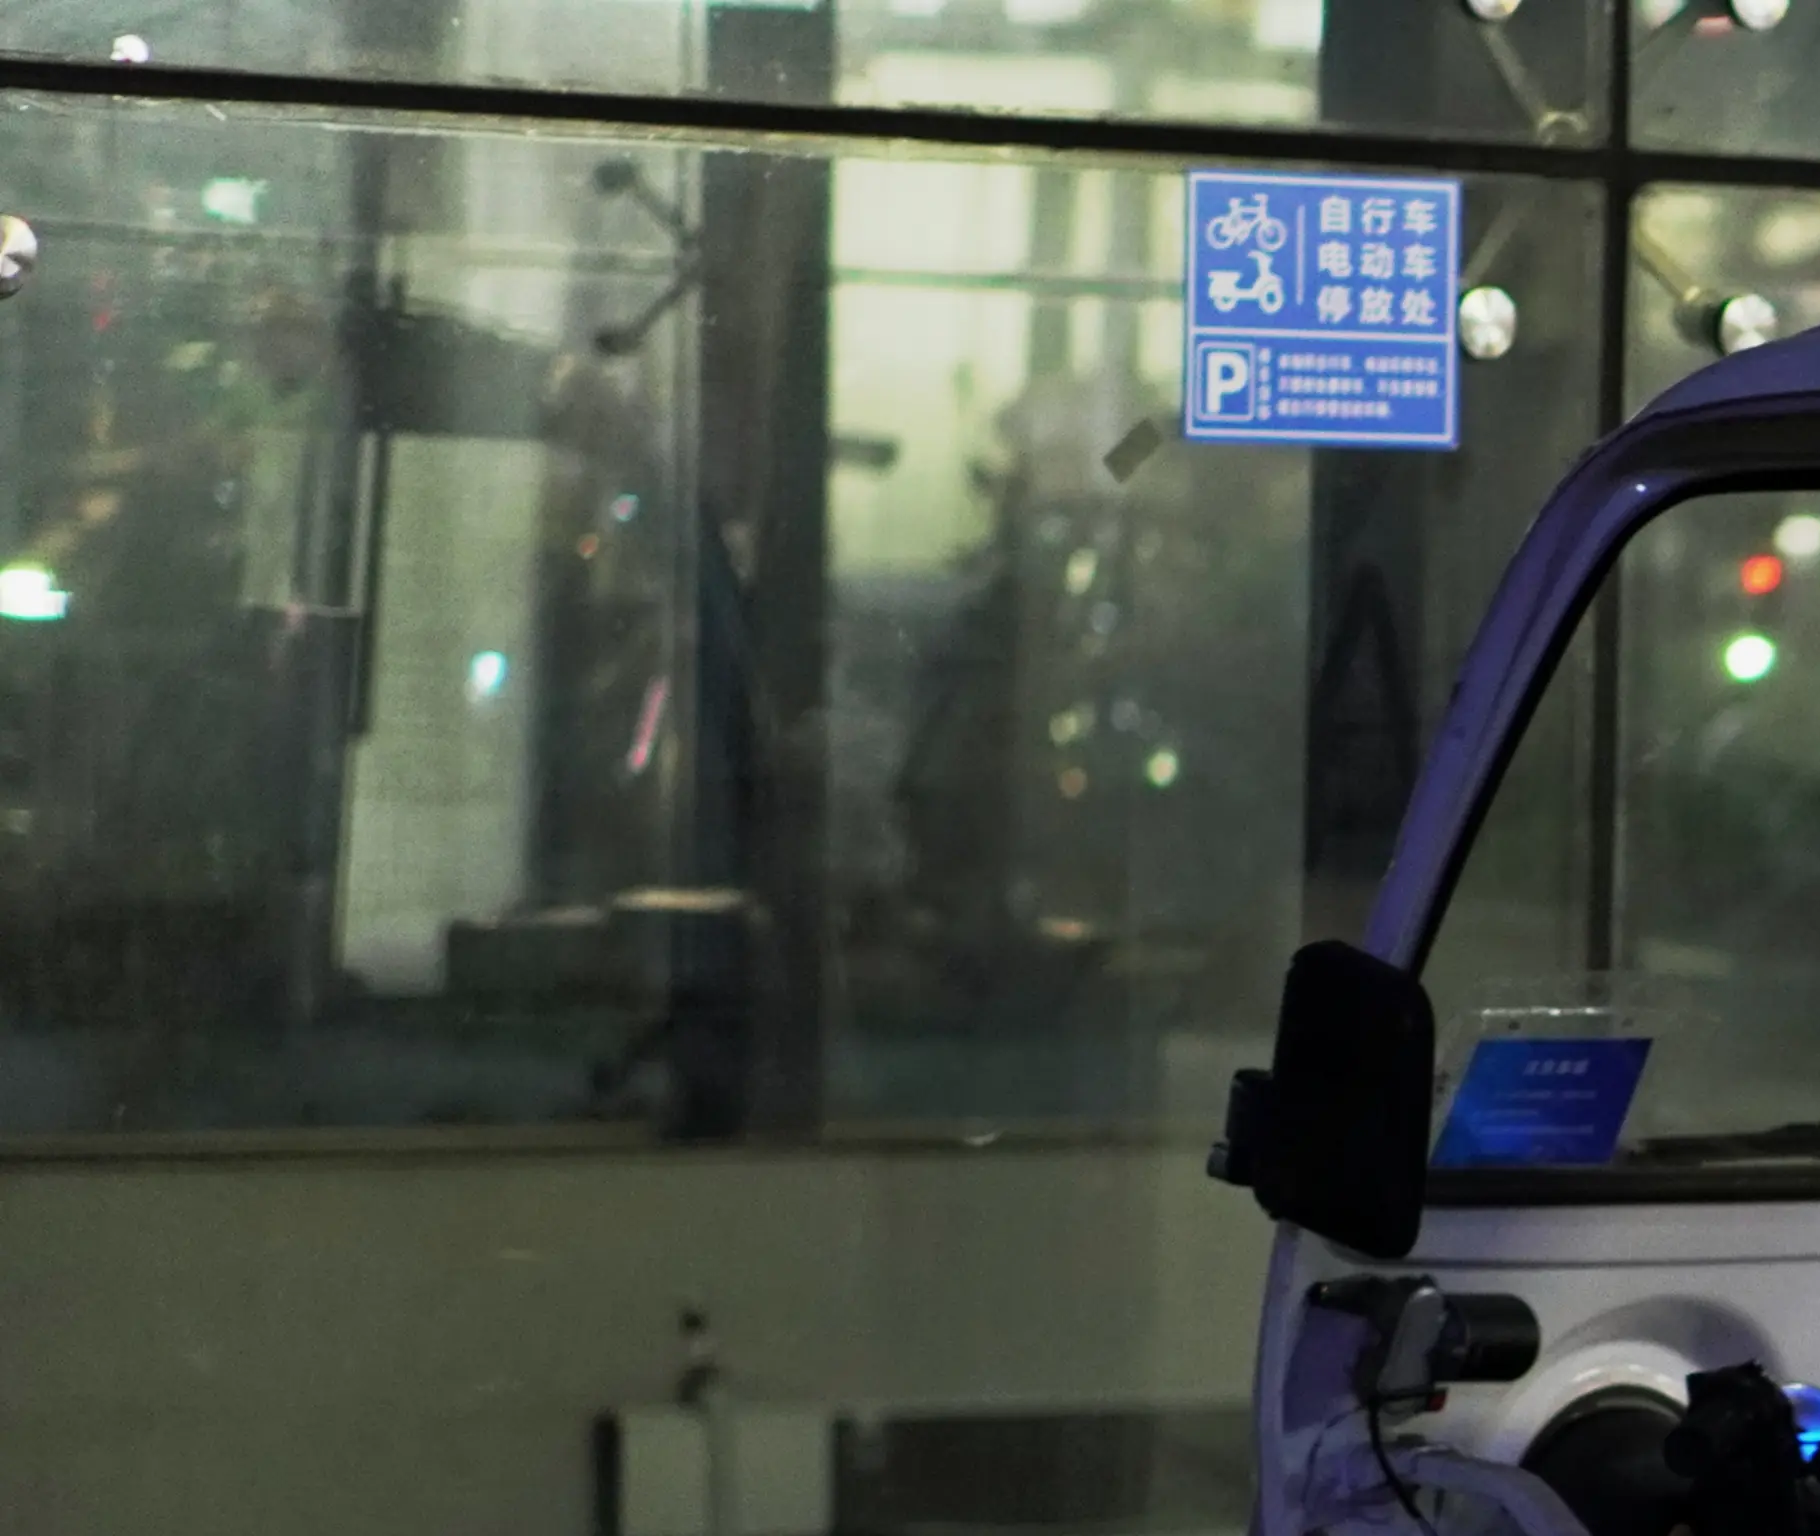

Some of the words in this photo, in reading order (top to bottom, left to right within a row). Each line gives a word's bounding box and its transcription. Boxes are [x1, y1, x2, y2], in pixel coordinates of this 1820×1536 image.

[1318, 194, 1438, 236] 自行车
[1317, 240, 1438, 281] 电动车
[1316, 285, 1438, 326] 停放处
[1206, 351, 1249, 414] P
